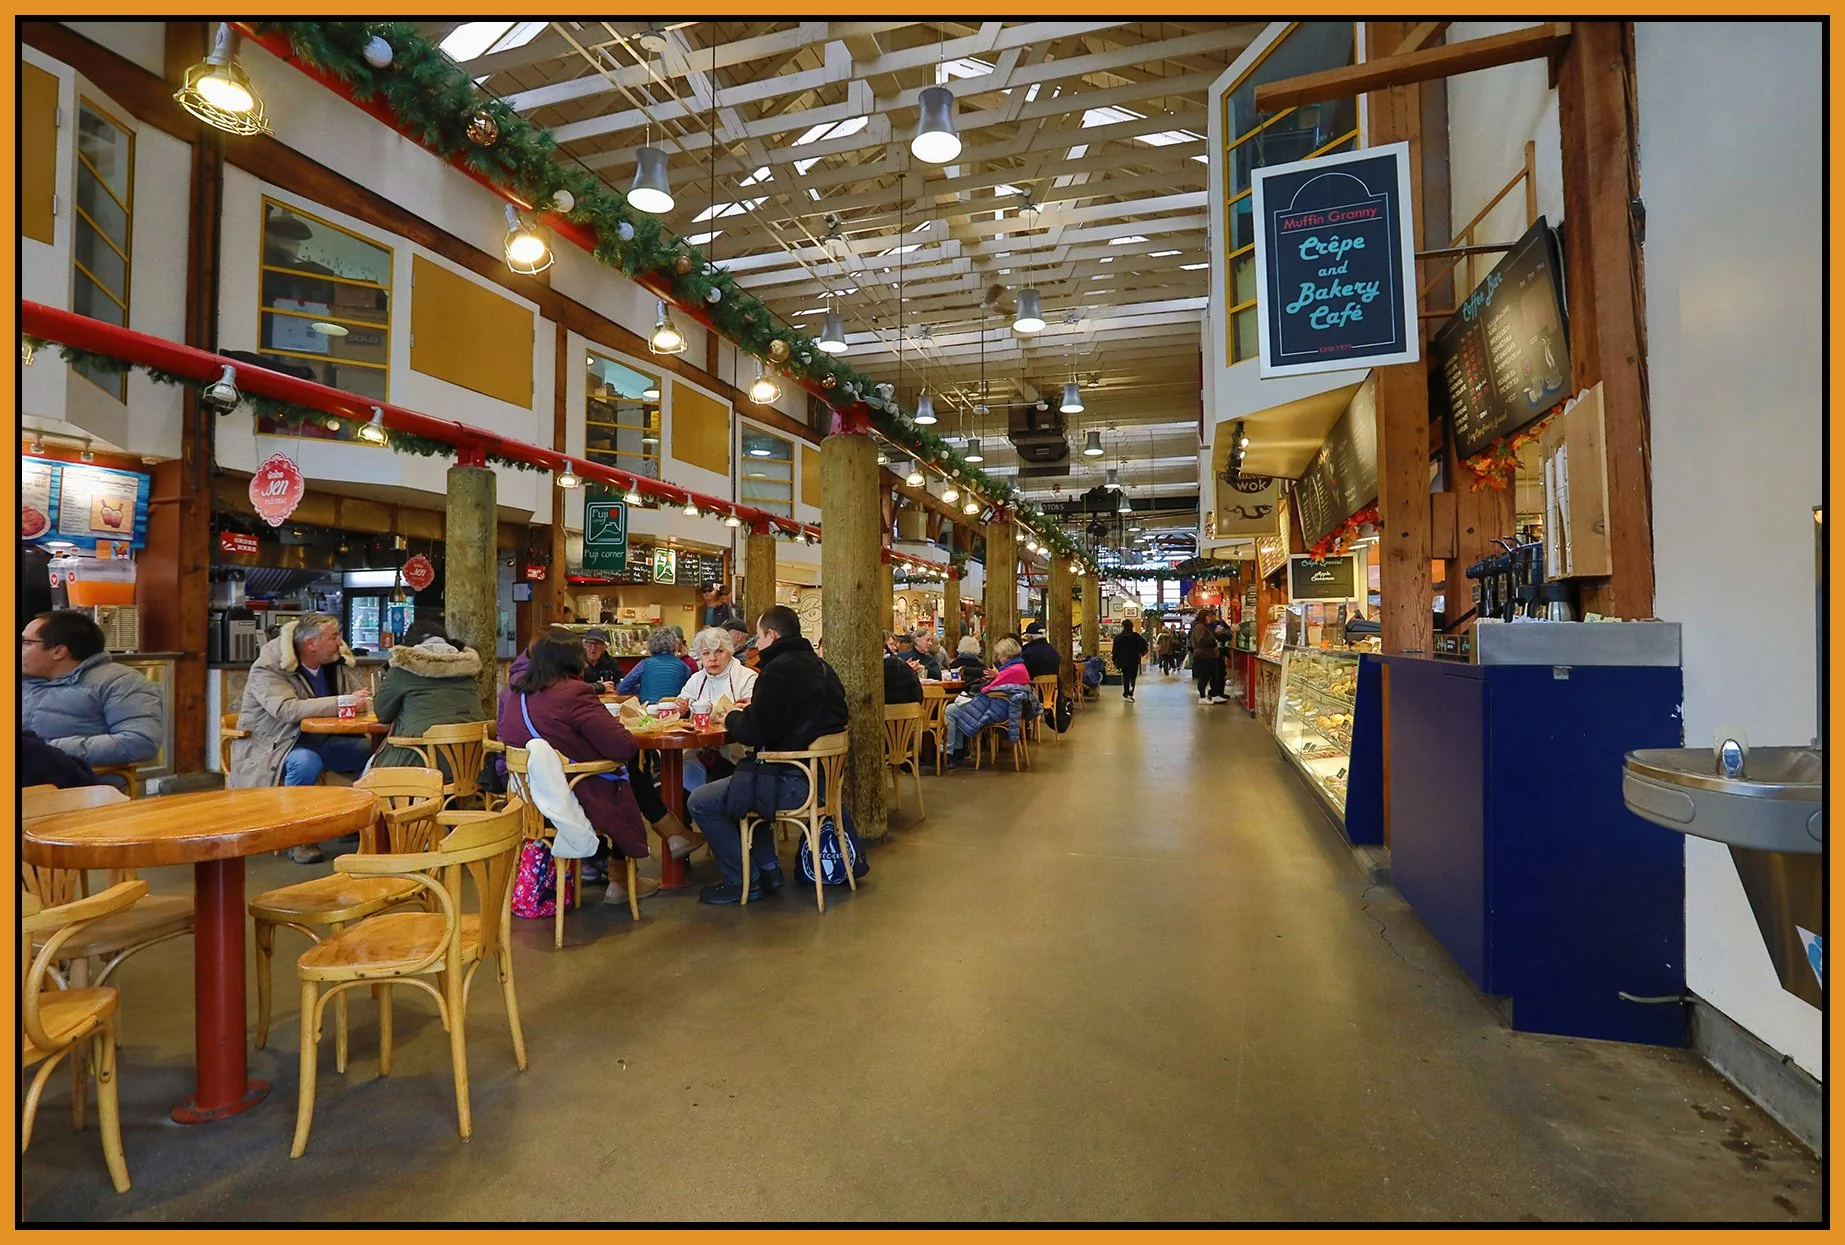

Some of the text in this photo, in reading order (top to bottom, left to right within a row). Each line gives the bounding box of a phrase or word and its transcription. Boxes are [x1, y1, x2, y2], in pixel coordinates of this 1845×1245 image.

[1283, 207, 1378, 230] Muffin Granny
[1298, 235, 1366, 261] Crêpe
[1318, 260, 1348, 277] and
[1285, 278, 1380, 314] Bakery
[1463, 290, 1485, 322] Coffee
[1485, 271, 1503, 307] Bar
[1309, 301, 1364, 330] Café
[592, 508, 609, 525] Fuji
[234, 537, 257, 546] ORDER
[584, 548, 599, 564] Fuji
[1314, 570, 1331, 578] Apple
